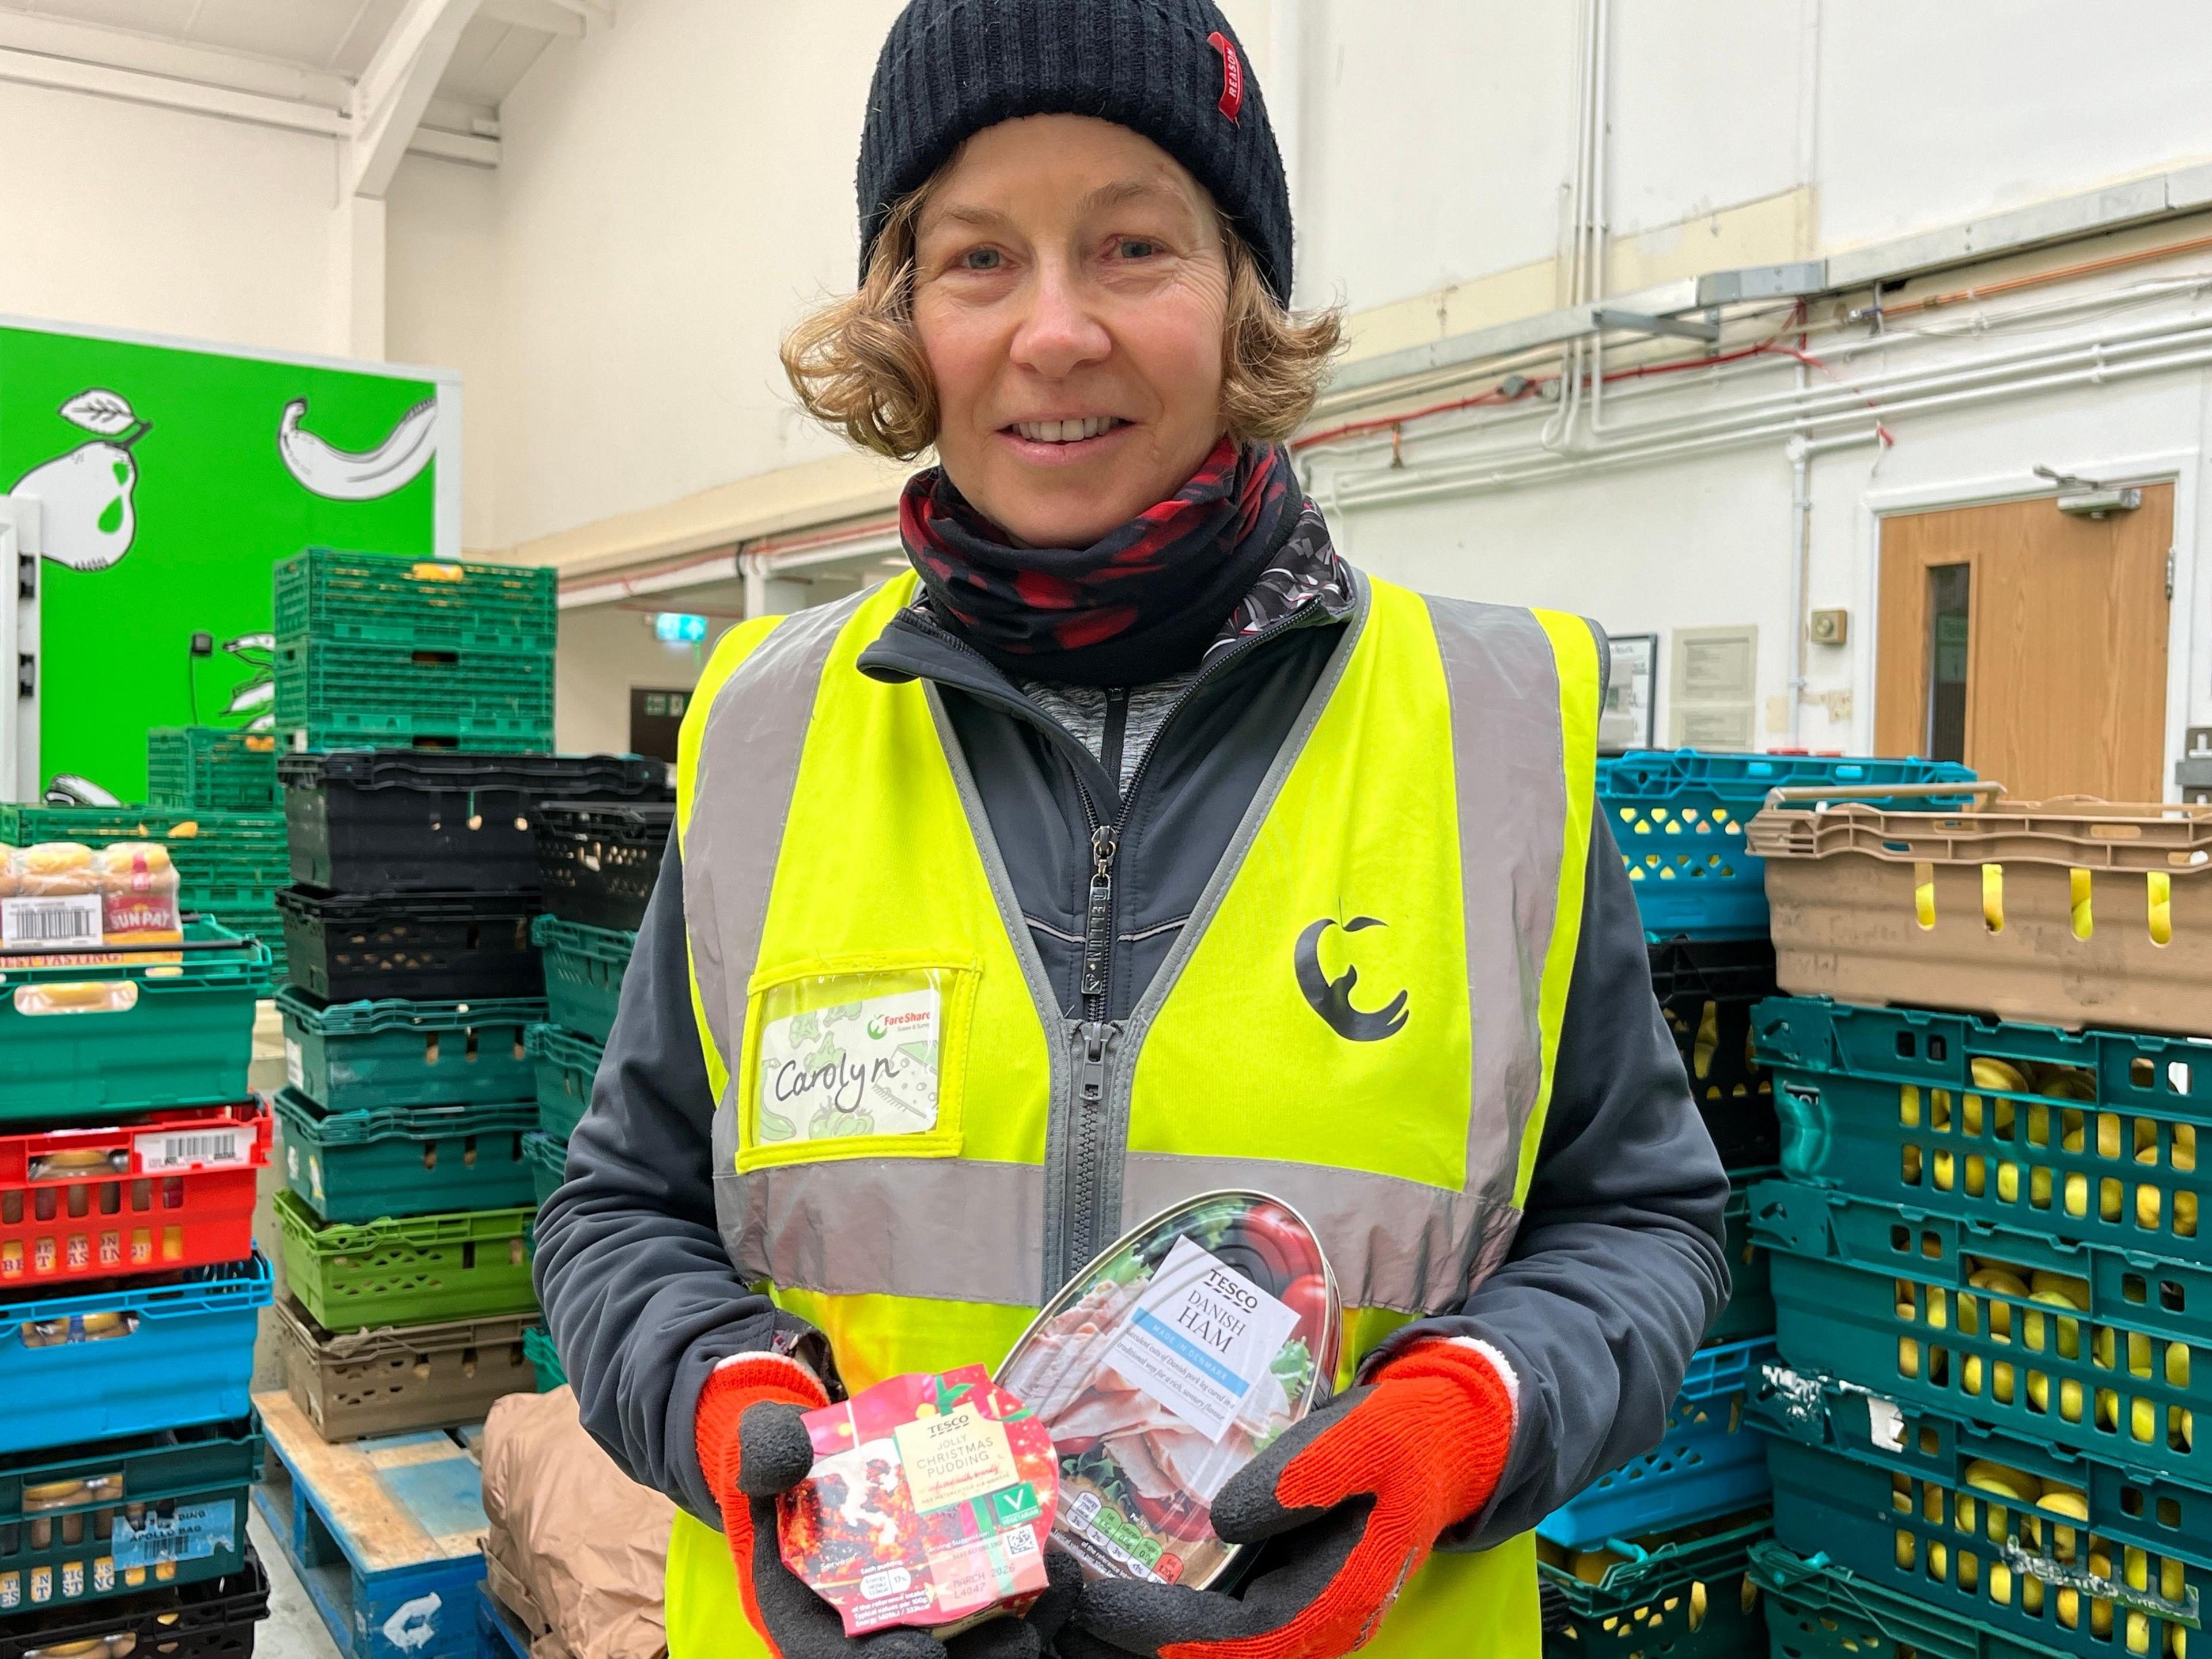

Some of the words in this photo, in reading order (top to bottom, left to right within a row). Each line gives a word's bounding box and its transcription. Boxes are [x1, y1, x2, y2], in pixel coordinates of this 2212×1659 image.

[1226, 47, 1237, 97] REASON
[0, 956, 37, 967] EST
[776, 1052, 900, 1113] Carolyn
[1209, 1269, 1258, 1309] TESCO
[1188, 1290, 1246, 1336] DANISH
[1177, 1305, 1234, 1354] HAM
[1124, 1327, 1151, 1350] Succulent
[1149, 1344, 1161, 1358] cuts
[1160, 1352, 1170, 1363] of
[1166, 1357, 1188, 1375] Danish
[1185, 1372, 1201, 1384] pork
[1207, 1385, 1225, 1402] cured
[1152, 1325, 1176, 1344] MADE
[1177, 1343, 1187, 1352] IN
[1188, 1349, 1228, 1381] DENMARK
[1116, 1342, 1147, 1365] traditional
[1145, 1362, 1158, 1374] way
[1154, 1367, 1166, 1379] for
[1182, 1388, 1205, 1407] savoury
[927, 1415, 969, 1434] TESCO
[916, 1437, 994, 1469] CHRISTMAS
[937, 1434, 967, 1450] JOLLY
[927, 1451, 989, 1478] PUDDING
[1002, 1508, 1039, 1525] VEGETARIAN
[1100, 1520, 1112, 1534] 1.5g
[1119, 1535, 1132, 1550] 0.6g
[1088, 1545, 1099, 1556] the
[1095, 1552, 1120, 1574] reference
[1139, 1550, 1153, 1566] 0.0g
[953, 1571, 986, 1588] MARCH
[991, 1563, 1016, 1578] 2026
[955, 1583, 986, 1599] L4047
